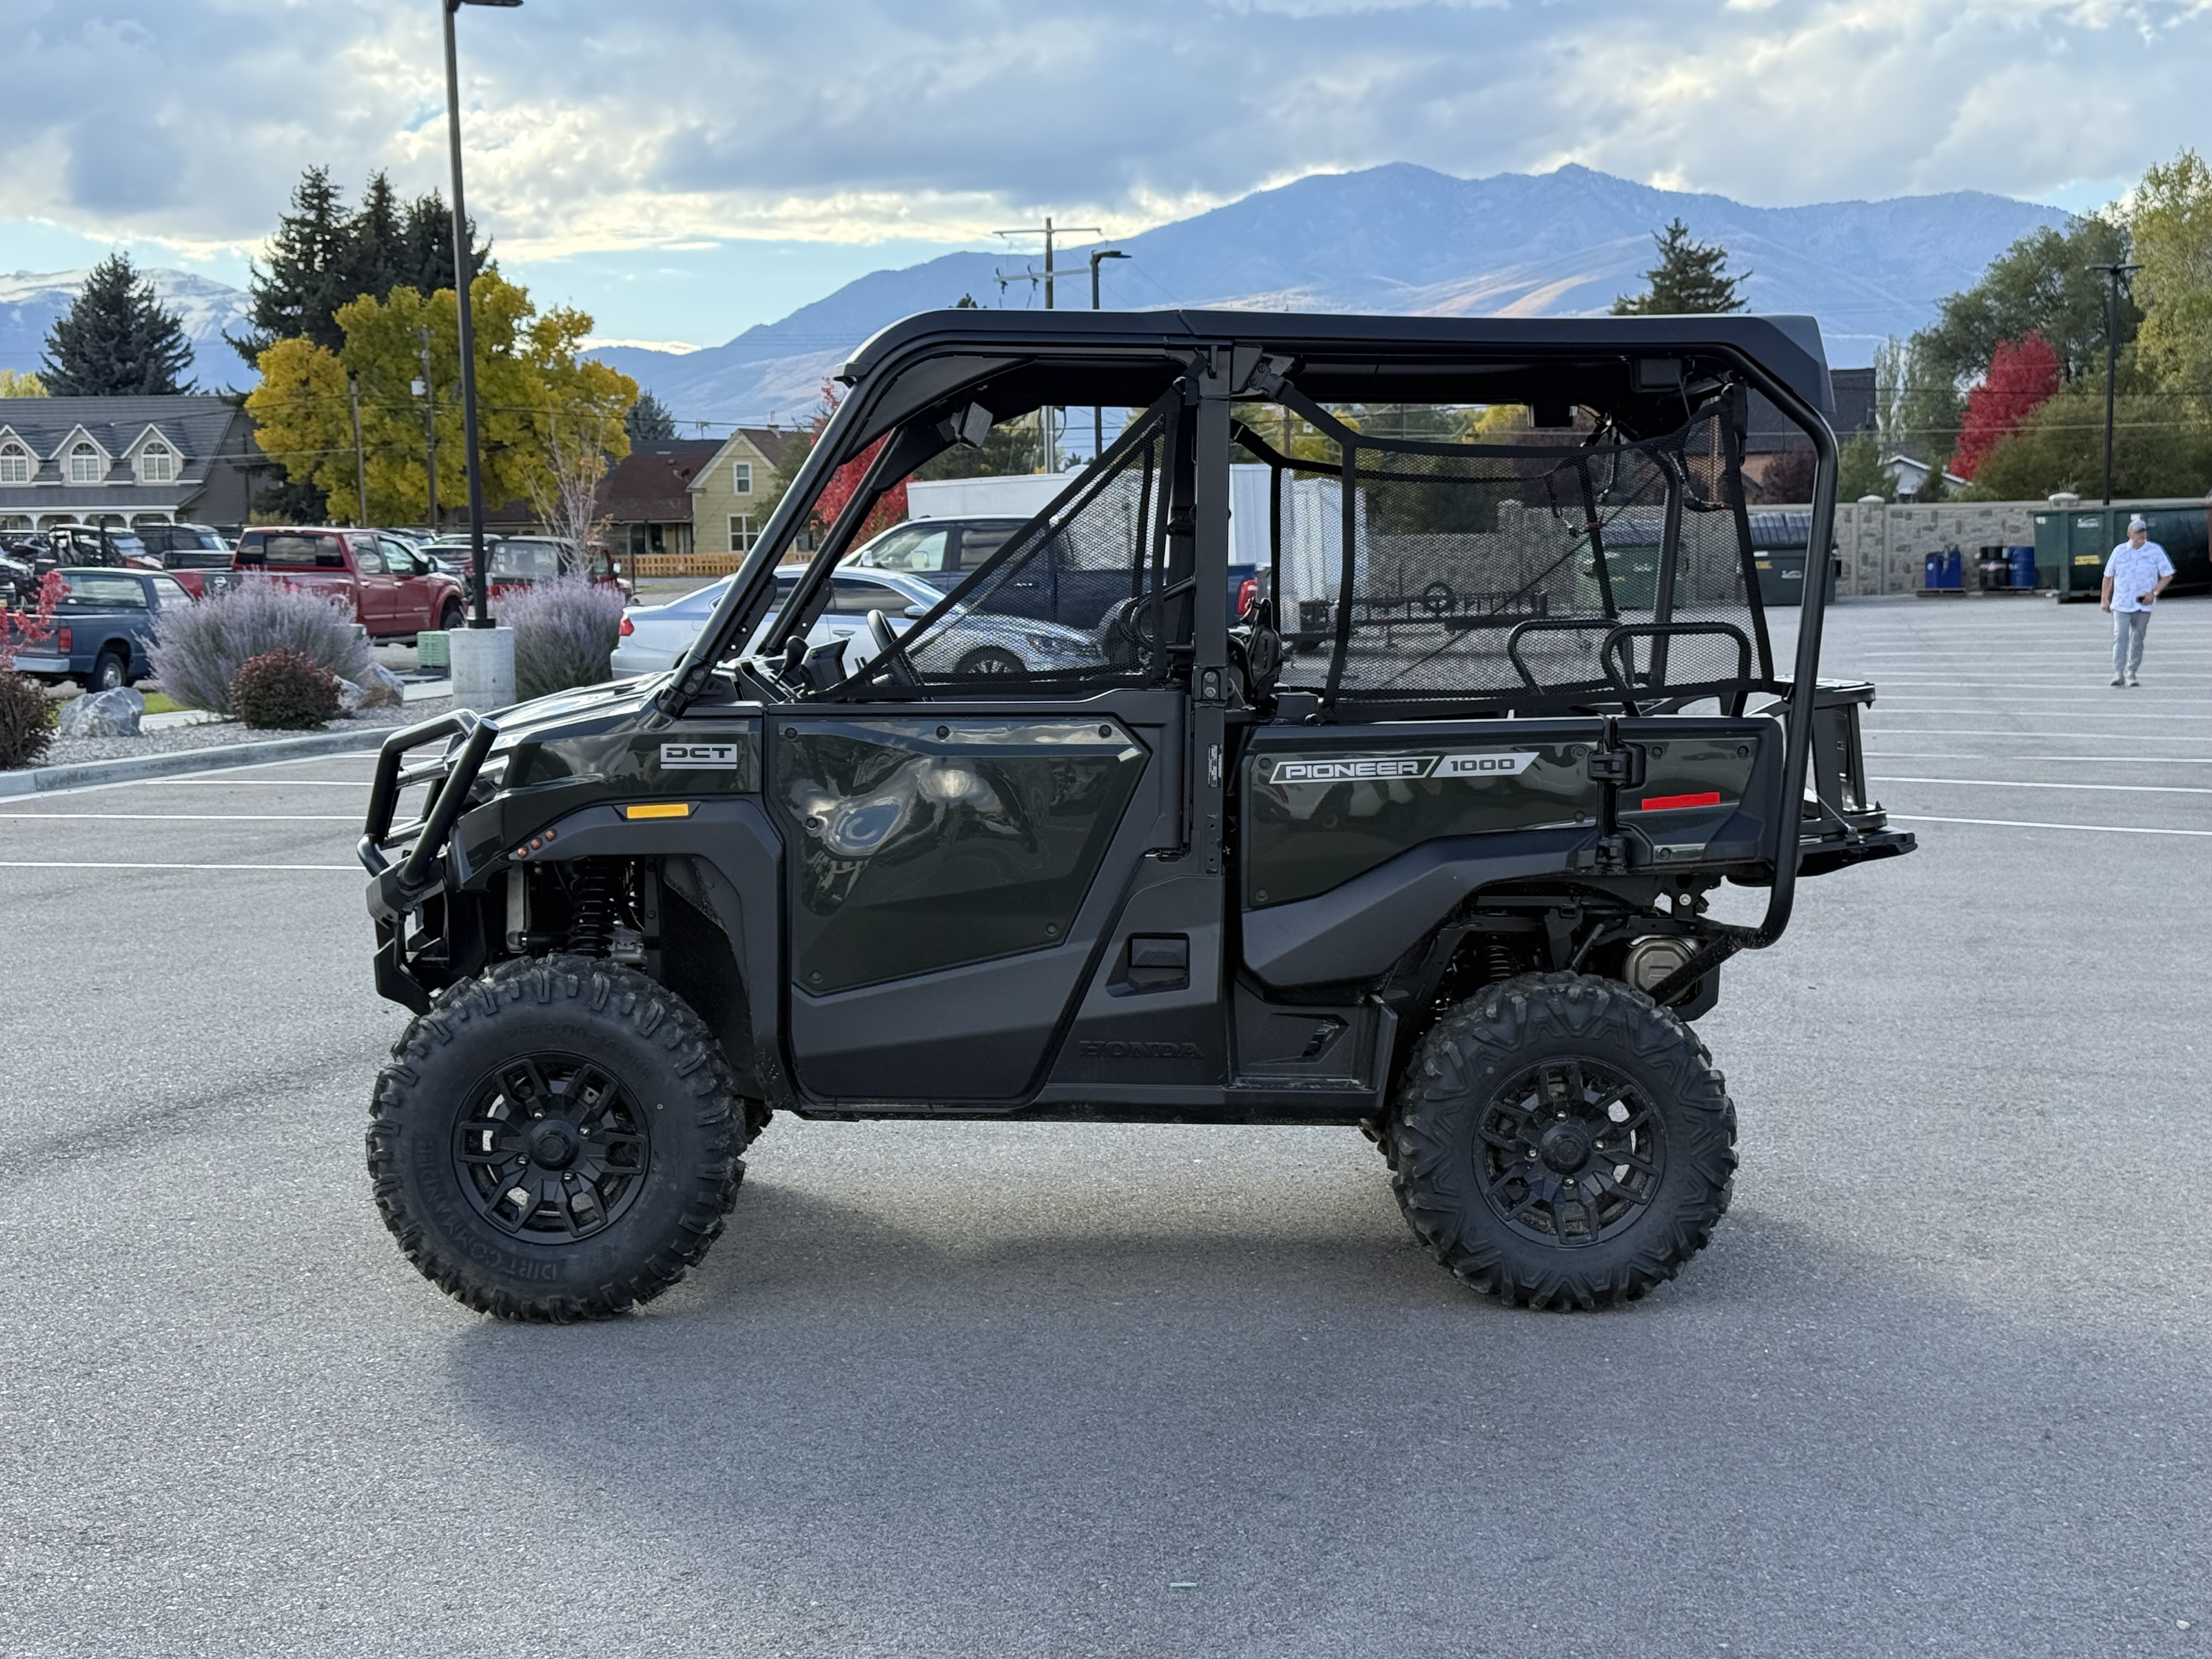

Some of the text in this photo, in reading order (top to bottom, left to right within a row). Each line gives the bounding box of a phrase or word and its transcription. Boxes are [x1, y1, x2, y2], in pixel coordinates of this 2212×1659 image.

[666, 747, 732, 759] DCT
[1285, 759, 1516, 779] PIONEER 1000
[1079, 1040, 1205, 1059] HONDA
[415, 1137, 557, 1280] DIRT COMMANDER
